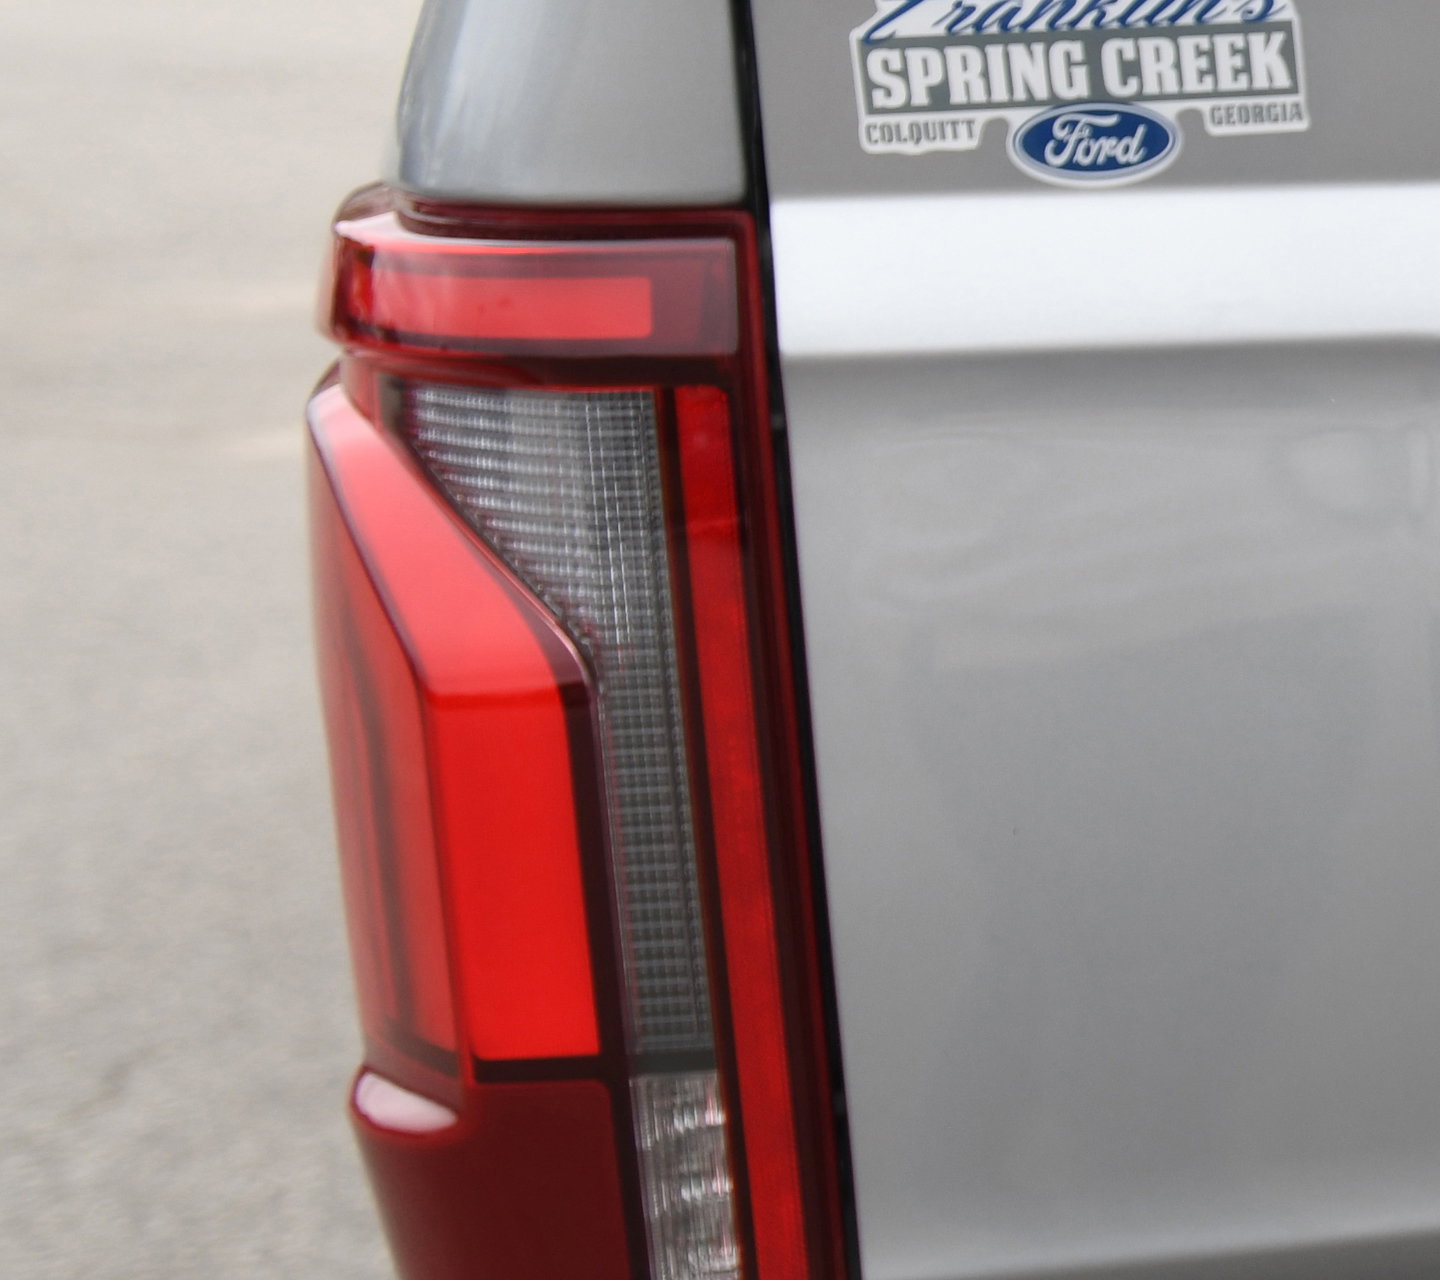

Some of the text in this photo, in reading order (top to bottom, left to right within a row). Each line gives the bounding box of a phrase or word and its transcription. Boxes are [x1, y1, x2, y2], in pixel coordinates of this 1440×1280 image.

[866, 31, 1293, 109] SPRING CREEK
[864, 119, 977, 146] COLQUITT
[1209, 102, 1304, 127] GEORGIA
[1044, 112, 1147, 168] Ford
